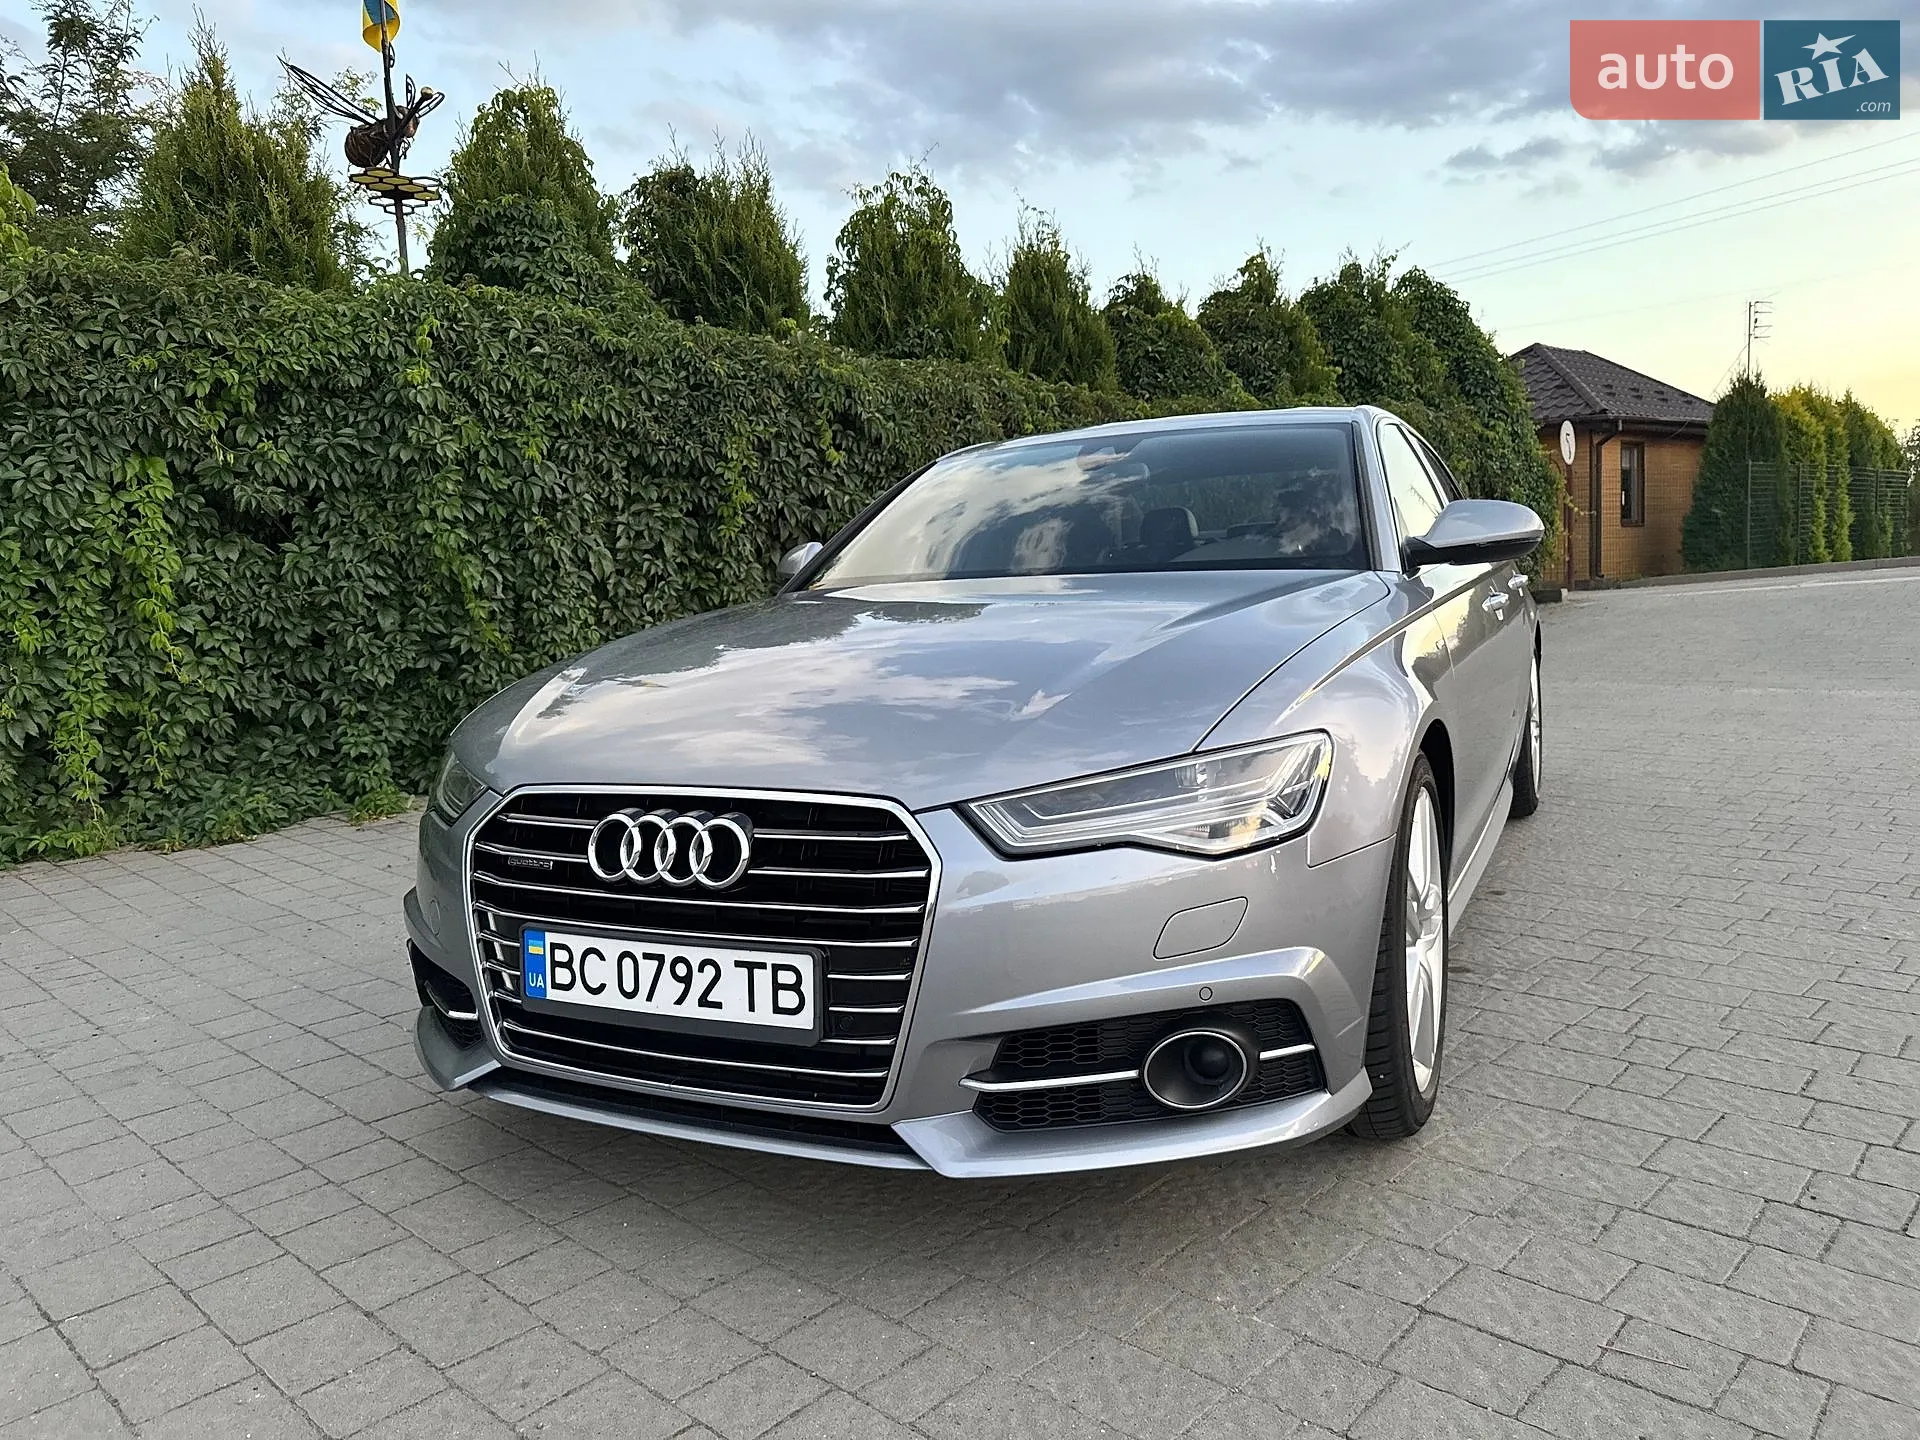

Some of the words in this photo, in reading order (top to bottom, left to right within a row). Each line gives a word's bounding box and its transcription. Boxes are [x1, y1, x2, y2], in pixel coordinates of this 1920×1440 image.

[529, 973, 545, 989] UA
[549, 941, 607, 995] BC
[617, 950, 723, 1010] 0792
[734, 960, 806, 1016] TB
